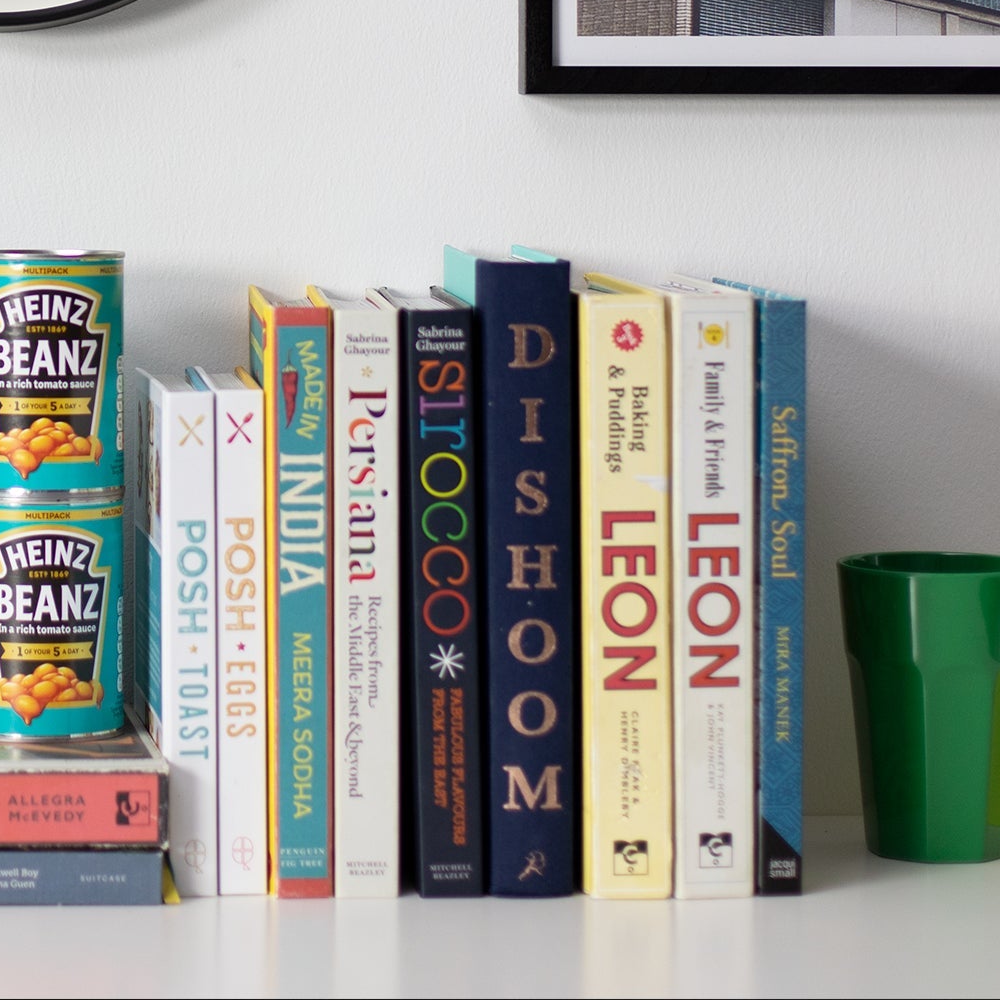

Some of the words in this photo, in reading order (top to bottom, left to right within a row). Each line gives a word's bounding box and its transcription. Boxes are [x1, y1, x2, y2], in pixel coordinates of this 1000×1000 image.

[24, 267, 69, 275] MULTIPACK
[5, 295, 90, 326] HEINZ
[344, 345, 390, 356] Ghayour
[346, 333, 388, 343] Sabrina
[415, 339, 466, 352] Ghayour
[418, 326, 463, 338] Sabrina
[296, 339, 325, 411] MADE
[608, 365, 624, 380] &
[700, 361, 726, 414] Family
[296, 413, 320, 440] IN
[604, 387, 626, 473] Puddings
[628, 386, 649, 452] Baking
[704, 420, 725, 433] &
[703, 439, 726, 499] Friends
[771, 406, 798, 511] Saffron
[347, 386, 389, 584] Persiana
[26, 512, 71, 520] MULTIPACK
[279, 452, 325, 595] INDIA
[8, 540, 92, 571] HEINZ
[502, 323, 562, 811] DISHOOM
[771, 519, 797, 579] Soul
[177, 520, 208, 634] POSH
[225, 517, 256, 631] POSH
[348, 595, 363, 621] the
[601, 510, 657, 691] LEON
[688, 512, 740, 688] LEON
[16, 625, 35, 634] rich
[36, 625, 71, 635] tomato
[72, 625, 97, 633] sauce
[364, 595, 383, 657] Recipes
[348, 624, 363, 681] Middle
[292, 632, 313, 722] MEERA
[367, 660, 383, 708] from
[178, 663, 209, 760] TOAST
[226, 660, 257, 740] EGGS
[348, 685, 361, 718] East
[432, 688, 446, 732] FROM
[776, 677, 791, 744] MANEK
[450, 688, 465, 763] FABULOUS
[620, 711, 628, 752] HENRY
[631, 711, 640, 754] CLAIRE
[344, 739, 363, 799] beyond
[433, 735, 447, 766] THE
[292, 728, 313, 819] SODHA
[434, 769, 448, 809] EAST
[8, 794, 86, 806] ALLEGRA
[9, 811, 86, 822] McEVEDY
[452, 767, 468, 846] FLAVOURS
[280, 847, 326, 857] PENGUIN
[300, 859, 323, 868] TREE
[346, 860, 389, 869] MITCHELL
[429, 864, 473, 872] MITCHELL
[769, 858, 796, 869] jacqui
[10, 880, 36, 888] Guen
[22, 869, 39, 879] Boy
[769, 869, 796, 878] small
